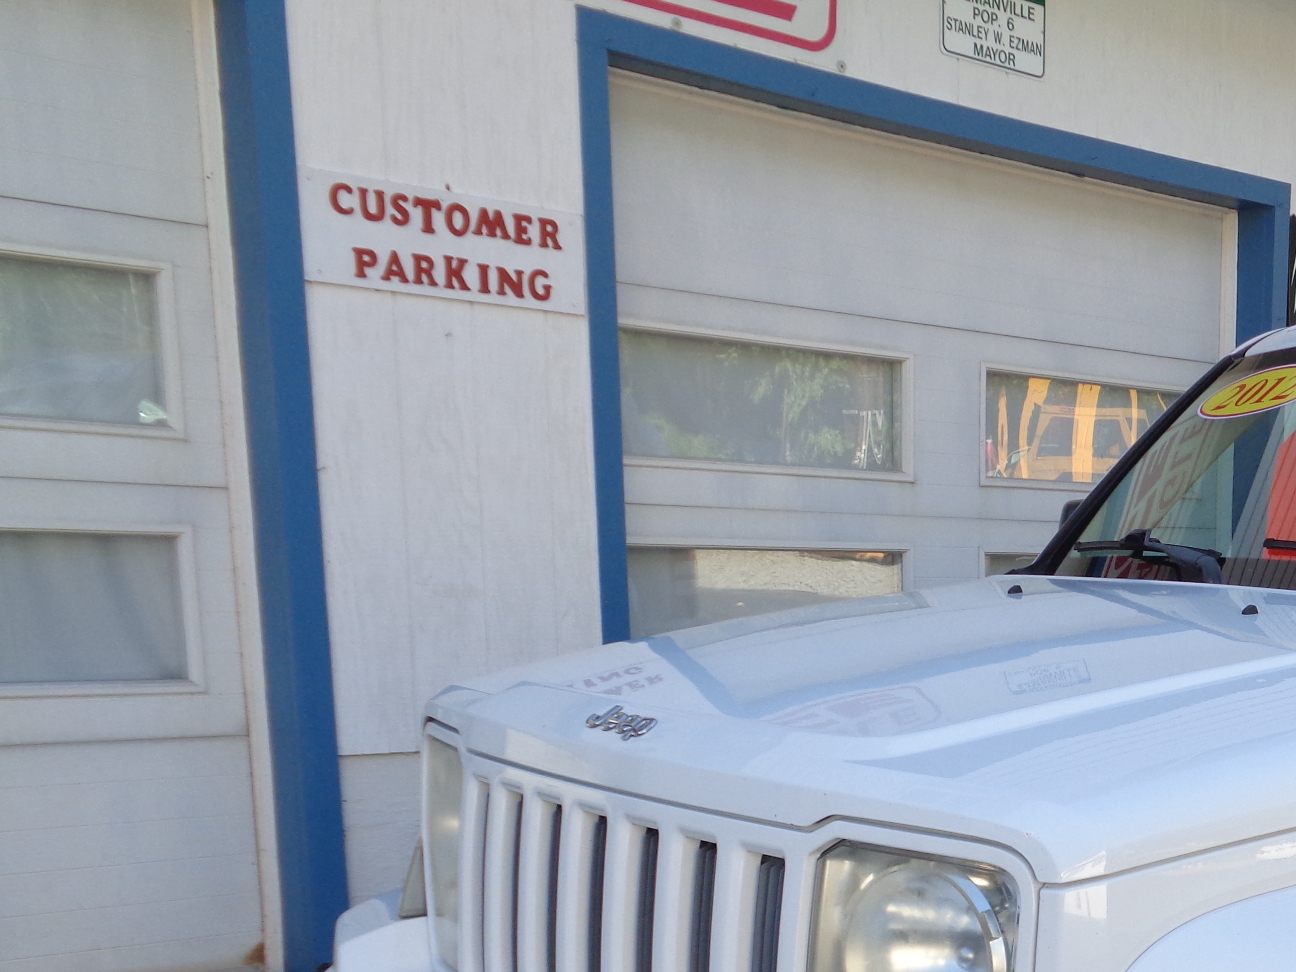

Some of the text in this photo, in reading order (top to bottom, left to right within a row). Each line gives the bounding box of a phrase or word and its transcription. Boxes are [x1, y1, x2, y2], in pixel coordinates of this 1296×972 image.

[945, 16, 1042, 57] STANLEY W. EZMAN
[972, 6, 1015, 31] POP. 6
[973, 42, 1016, 67] MAYOR
[328, 182, 563, 251] CUSTOMER
[351, 246, 553, 302] PARKING
[586, 705, 658, 741] Jeep
